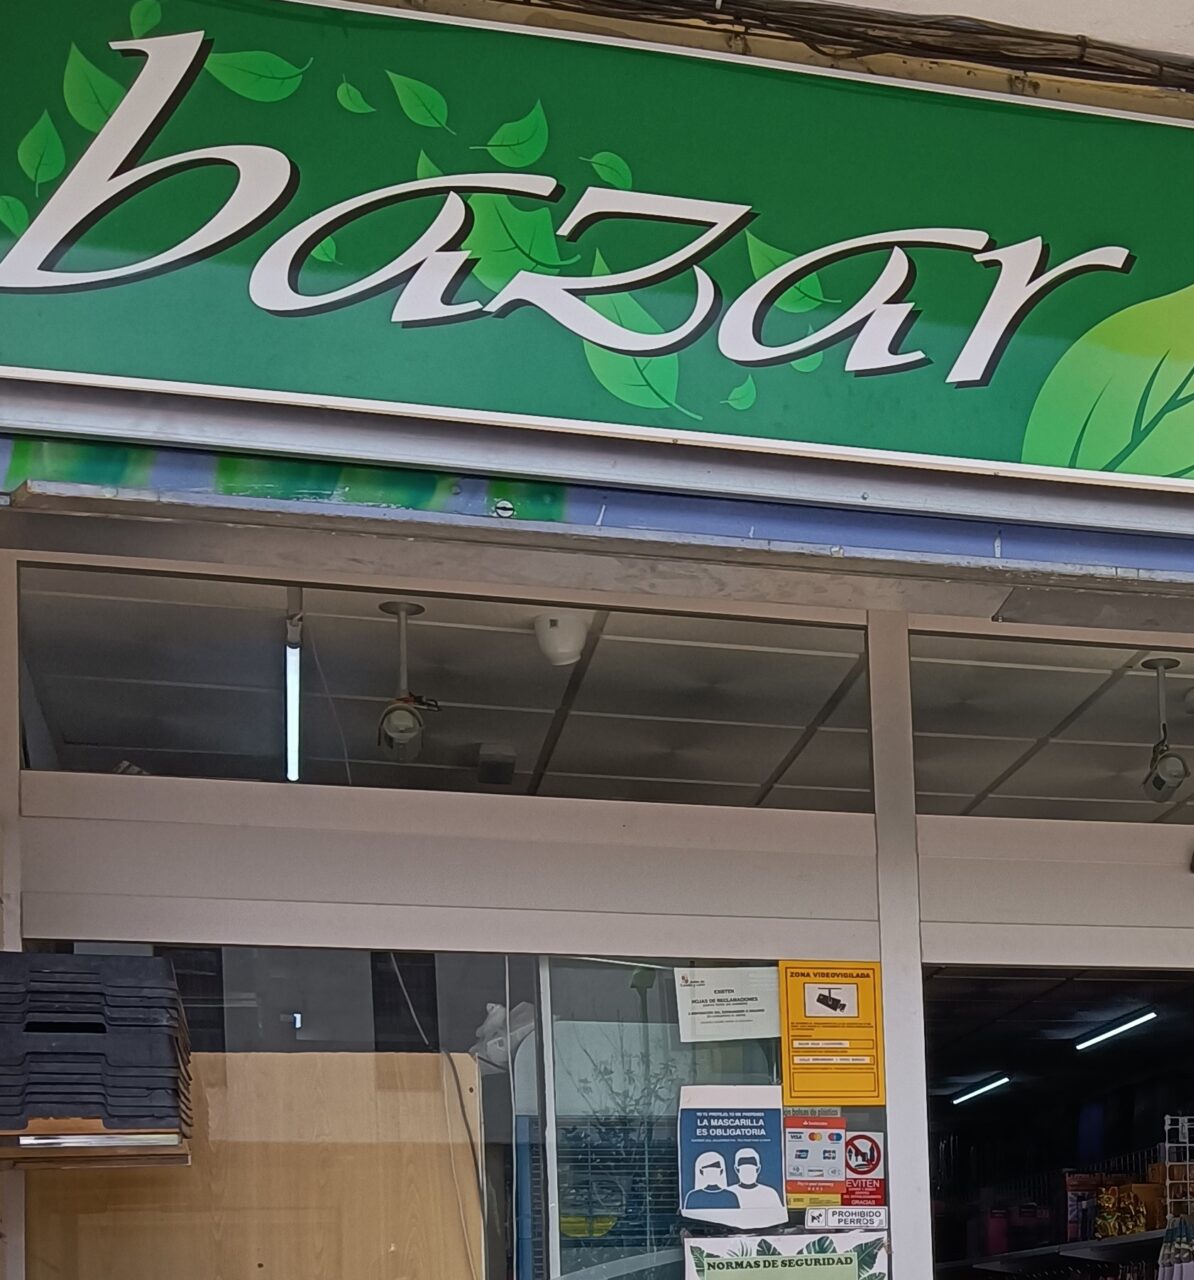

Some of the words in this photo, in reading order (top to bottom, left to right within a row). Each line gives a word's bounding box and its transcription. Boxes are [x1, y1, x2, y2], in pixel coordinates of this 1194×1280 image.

[0, 30, 1138, 388] bazar
[696, 1128, 708, 1136] ES
[709, 1128, 766, 1136] OBLIGATORIA
[846, 1179, 880, 1188] EVITEN
[832, 1210, 882, 1218] PROHIBIDO
[706, 1260, 760, 1271] NORMAS
[762, 1259, 779, 1269] DE
[781, 1256, 853, 1268] SEGURIDAD
